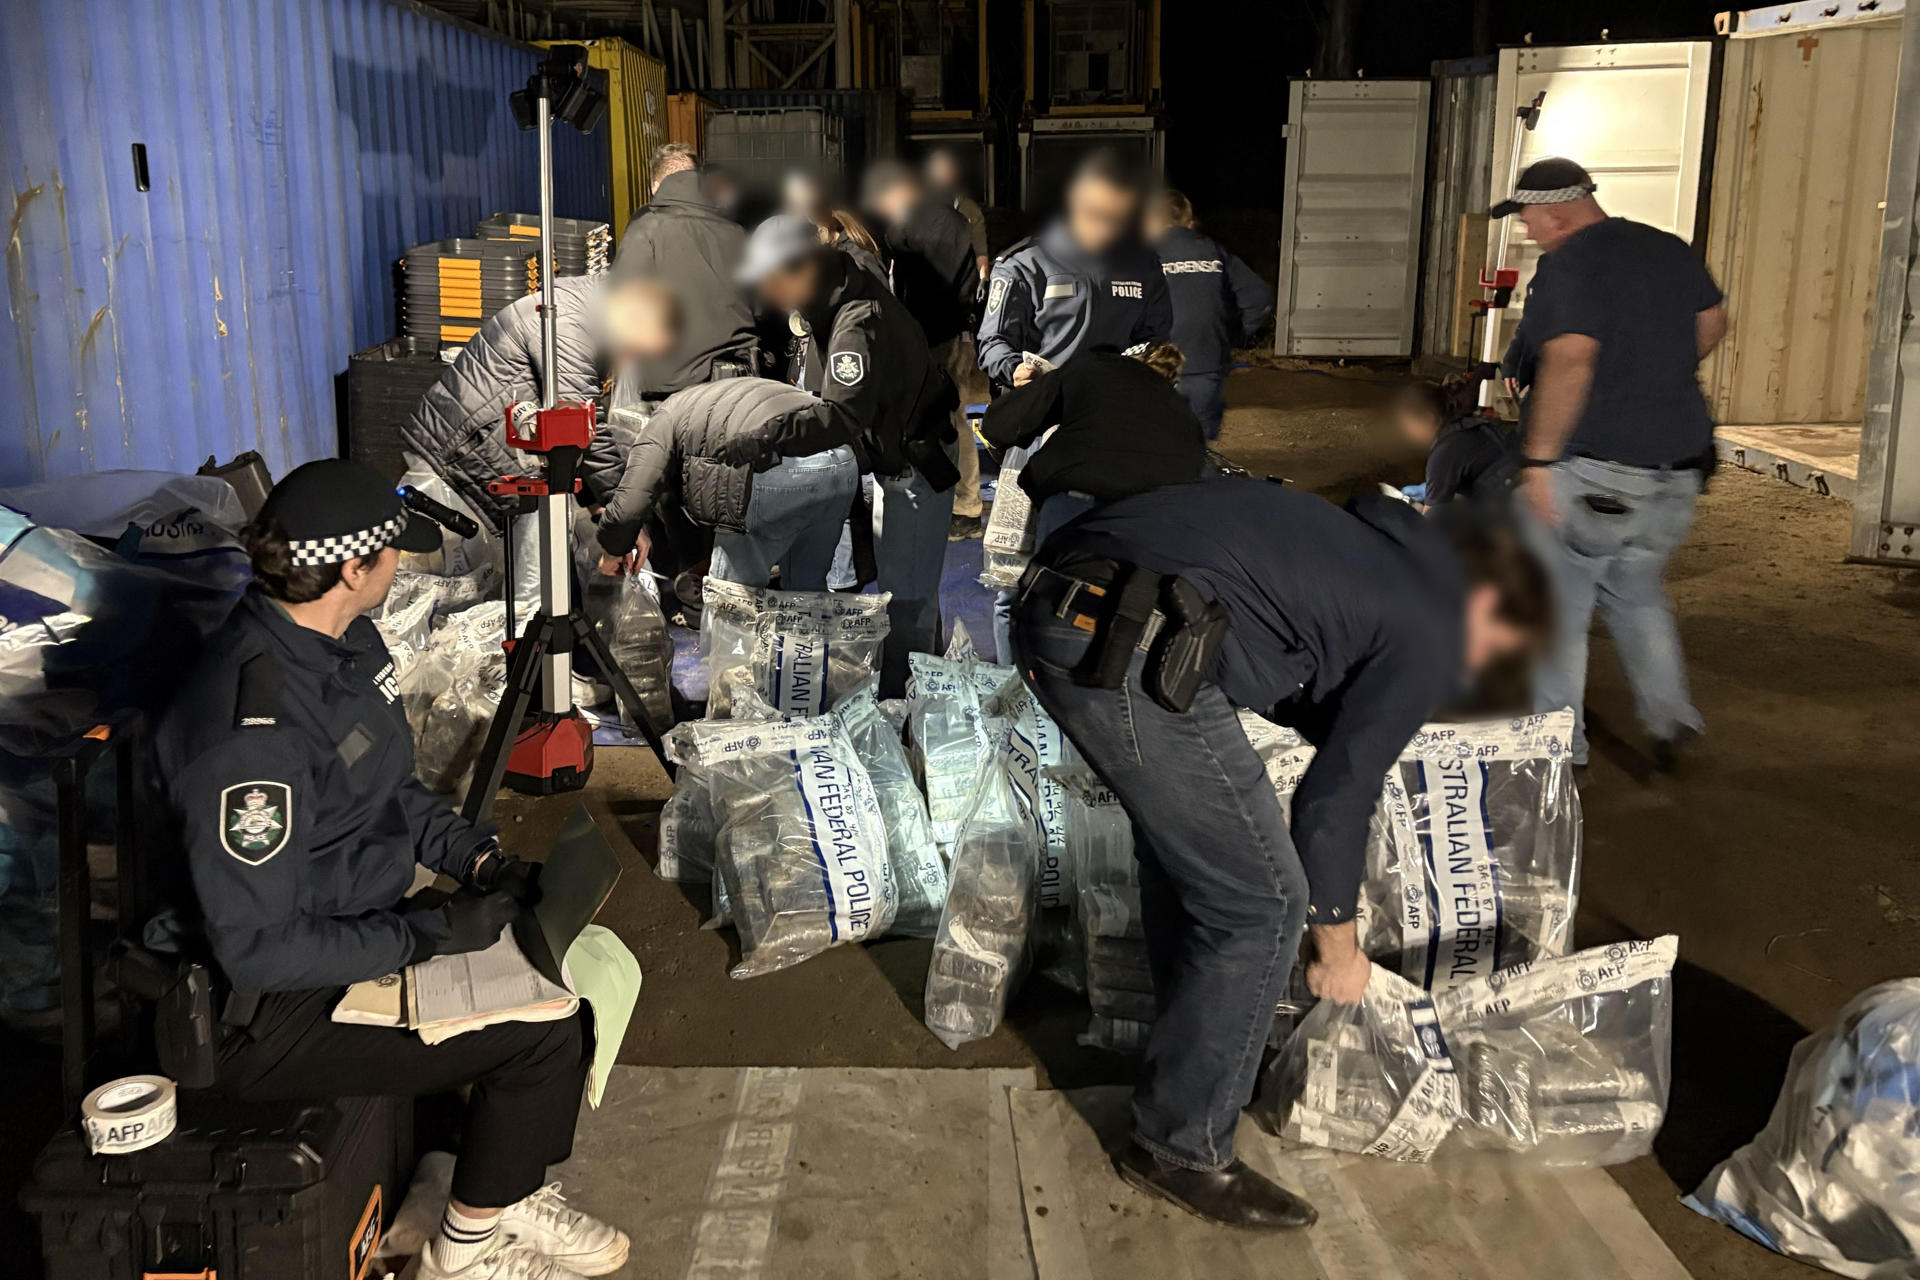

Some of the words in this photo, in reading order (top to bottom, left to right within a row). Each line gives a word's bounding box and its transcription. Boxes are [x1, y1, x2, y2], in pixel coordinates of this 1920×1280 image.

[1111, 285, 1143, 299] POLICE
[720, 602, 737, 611] AFP
[779, 600, 796, 609] AFP
[845, 608, 863, 616] AFP
[854, 617, 871, 626] AFP
[791, 642, 813, 705] RALIAN
[1527, 713, 1548, 727] AFP
[808, 730, 827, 740] AFP
[1431, 730, 1456, 742] AFP
[725, 740, 744, 752] AFP
[1476, 746, 1500, 757] AFP
[1288, 774, 1303, 786] AF
[1438, 759, 1473, 875] STRALIAN
[666, 825, 676, 846] AFP
[817, 783, 858, 867] FEDERAL
[844, 870, 872, 932] POLICE
[1477, 864, 1490, 889] BAG
[1482, 898, 1494, 911] 87
[1408, 905, 1420, 930] AFP
[1450, 883, 1481, 980] FEDERAL
[1628, 940, 1654, 953] AFP
[1507, 961, 1532, 978] AFP
[1599, 963, 1625, 980] AFP
[1484, 999, 1511, 1016] AFP
[107, 1122, 145, 1142] AFP
